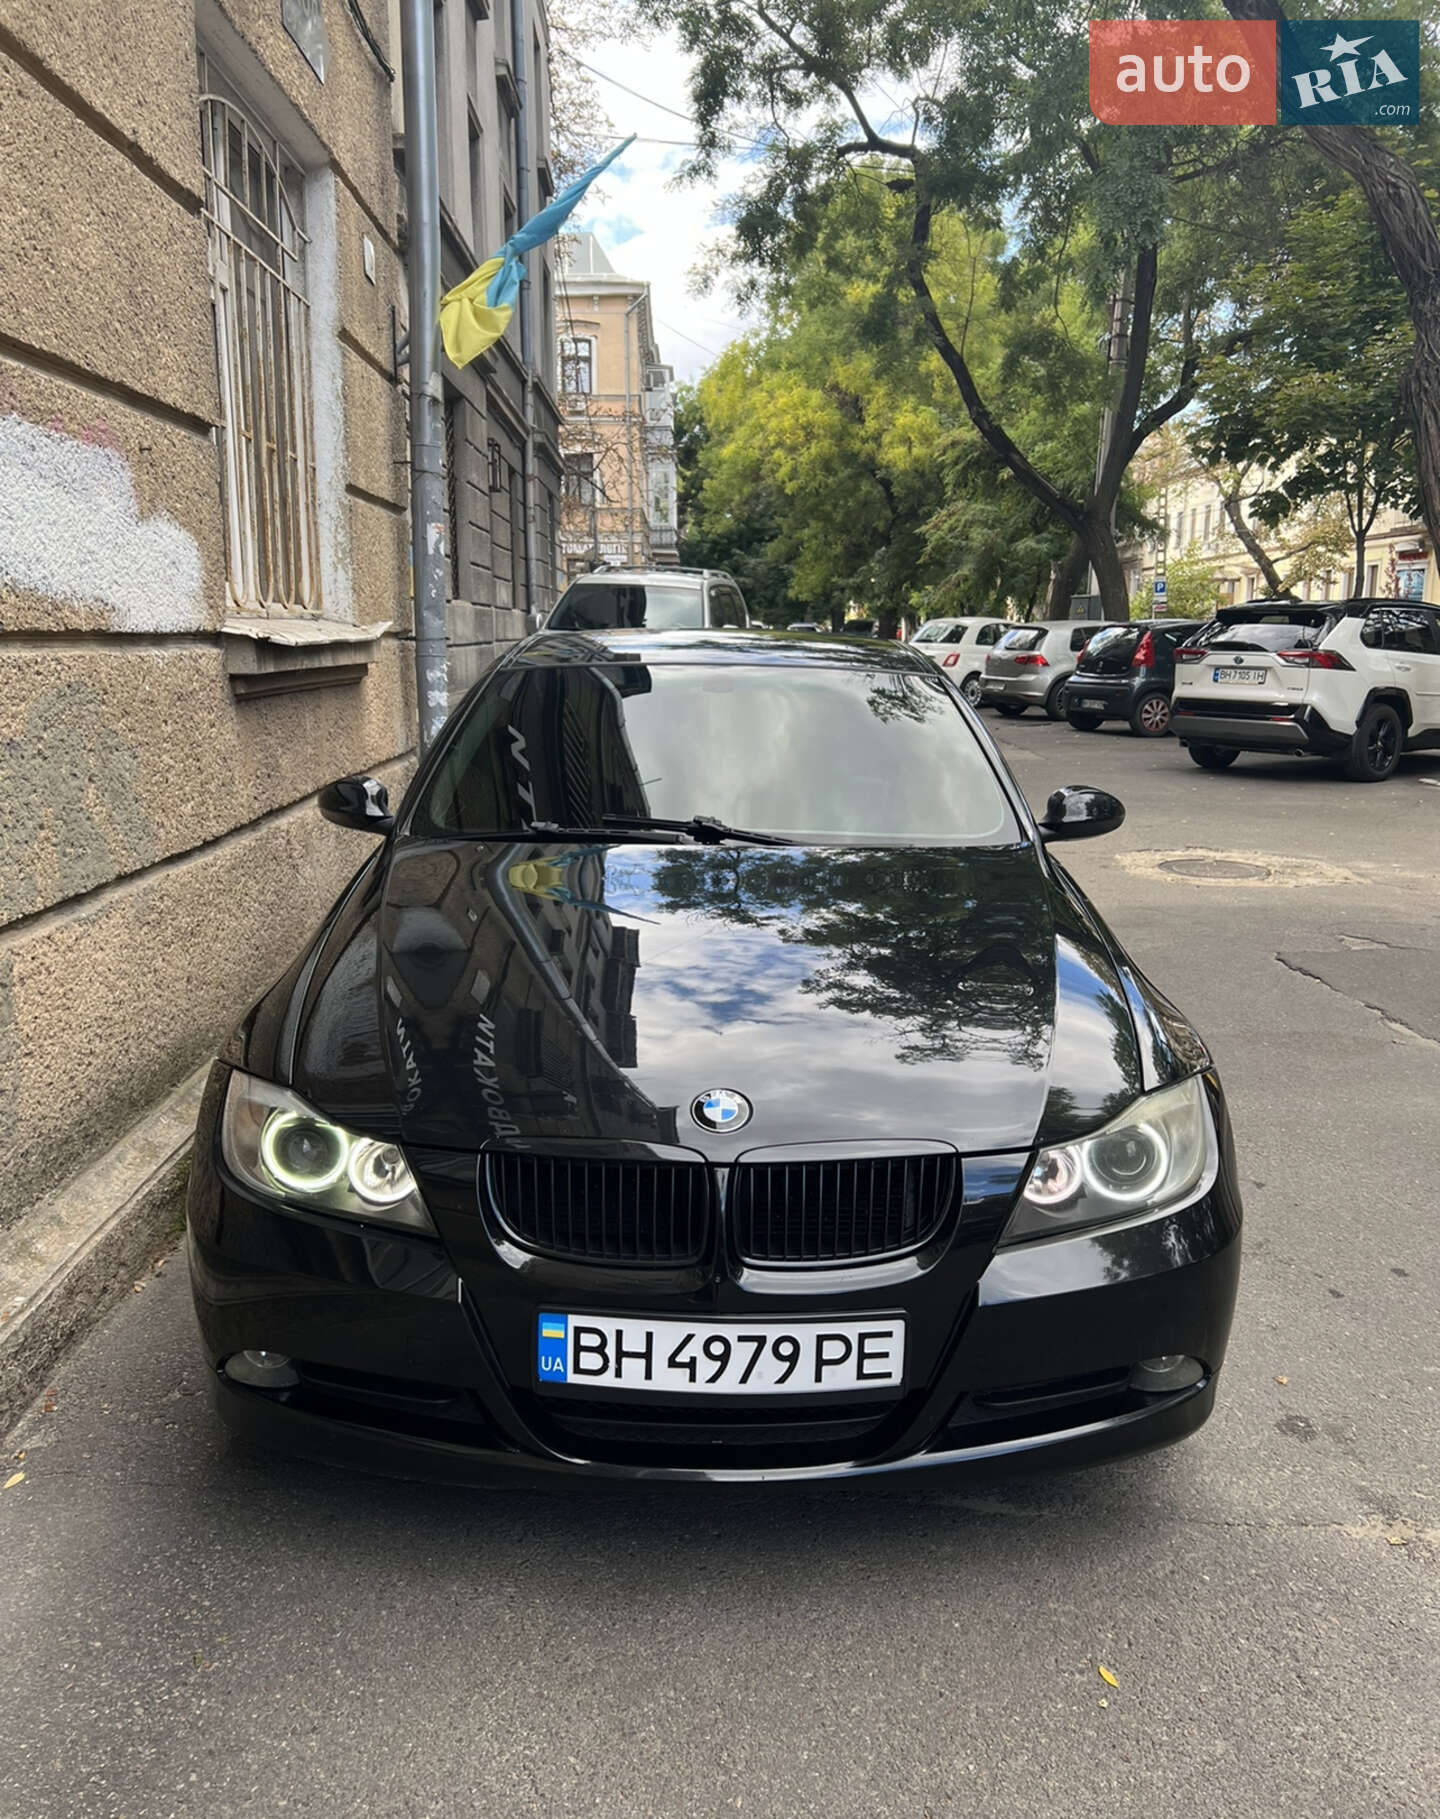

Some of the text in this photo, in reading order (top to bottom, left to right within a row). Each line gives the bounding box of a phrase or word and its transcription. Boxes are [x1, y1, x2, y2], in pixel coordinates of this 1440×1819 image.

[1156, 582, 1165, 592] P
[572, 1325, 894, 1385] BH 4979 PE
[541, 1356, 564, 1373] UA
